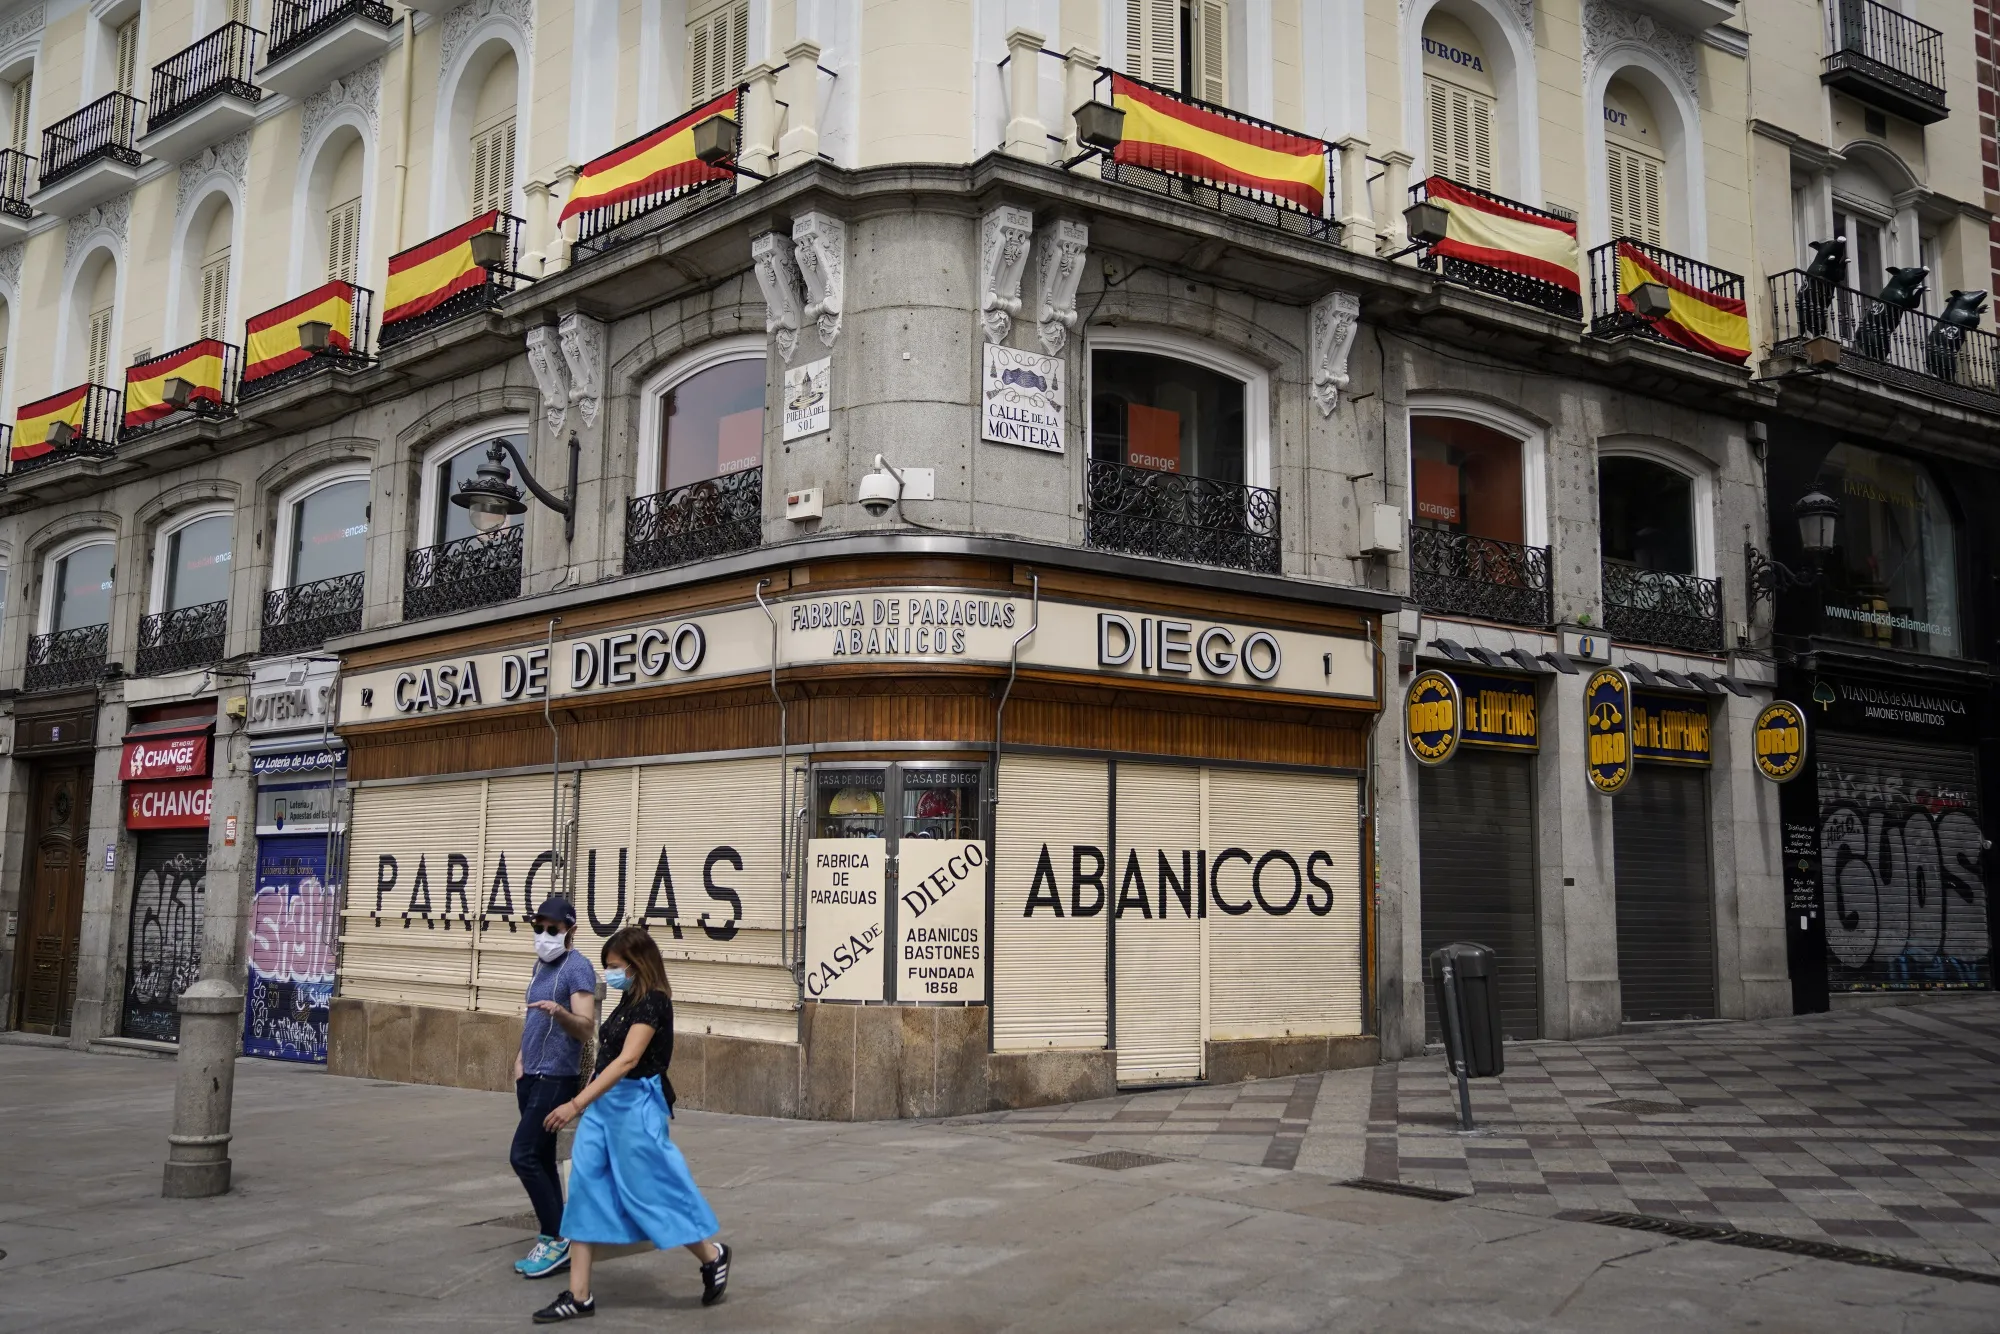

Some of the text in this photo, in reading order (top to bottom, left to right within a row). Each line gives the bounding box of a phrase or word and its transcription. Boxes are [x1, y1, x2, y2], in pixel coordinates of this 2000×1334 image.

[786, 405, 826, 423] PUERTA DEL
[798, 418, 815, 432] SOL
[990, 404, 1059, 427] CALLE DE LA
[988, 418, 1061, 448] MONTERA
[719, 456, 756, 472] orange
[1130, 451, 1175, 471] orange
[1419, 501, 1456, 518] orange
[791, 598, 1016, 630] FABRICA DE PARAGUAS
[1825, 604, 1952, 637] www.viandasdesalamanca.es
[833, 627, 966, 655] ABANICOS
[1097, 613, 1333, 681] DIEGO 1
[1584, 637, 1591, 653] 1
[361, 622, 706, 712] 12 CASA DE DIEGO
[1411, 679, 1449, 703] COMPRO
[1588, 673, 1624, 697] COMPRO
[318, 686, 336, 715] S
[1840, 684, 1966, 715] VIANDAS de SALAMANCA
[1410, 700, 1453, 733] ORO
[1465, 689, 1535, 737] DE EMPEÑOS
[1760, 708, 1796, 729] COMPRO
[1865, 706, 1945, 726] JAMONES Y EMBUTIDOS
[1649, 716, 1661, 749] DE
[1661, 708, 1708, 753] EMPEÑOS
[1758, 727, 1799, 756] ORO
[1412, 733, 1452, 757] EMPEÑO
[1591, 732, 1625, 765] ORO
[145, 747, 194, 767] CHANGE
[292, 755, 301, 767] de
[302, 754, 314, 766] Los
[1759, 755, 1798, 775] EMPEÑO
[818, 773, 883, 785] CASA DE DIEGO
[906, 773, 977, 784] CASA DE DIEGO
[1591, 766, 1626, 787] EMPEÑO
[142, 788, 212, 817] CHANGE
[817, 854, 869, 868] FABRICA
[832, 872, 849, 886] DE
[901, 843, 983, 918] DIEGO
[1023, 843, 1334, 919] ABANICOS
[370, 845, 744, 942] PARAGUAS
[811, 890, 877, 905] PARAGUAS
[906, 928, 978, 943] ABANICOS
[807, 922, 883, 997] CASA DE
[904, 945, 980, 960] BASTONES
[908, 967, 974, 979] FUNDADA
[925, 982, 958, 994] 1858
